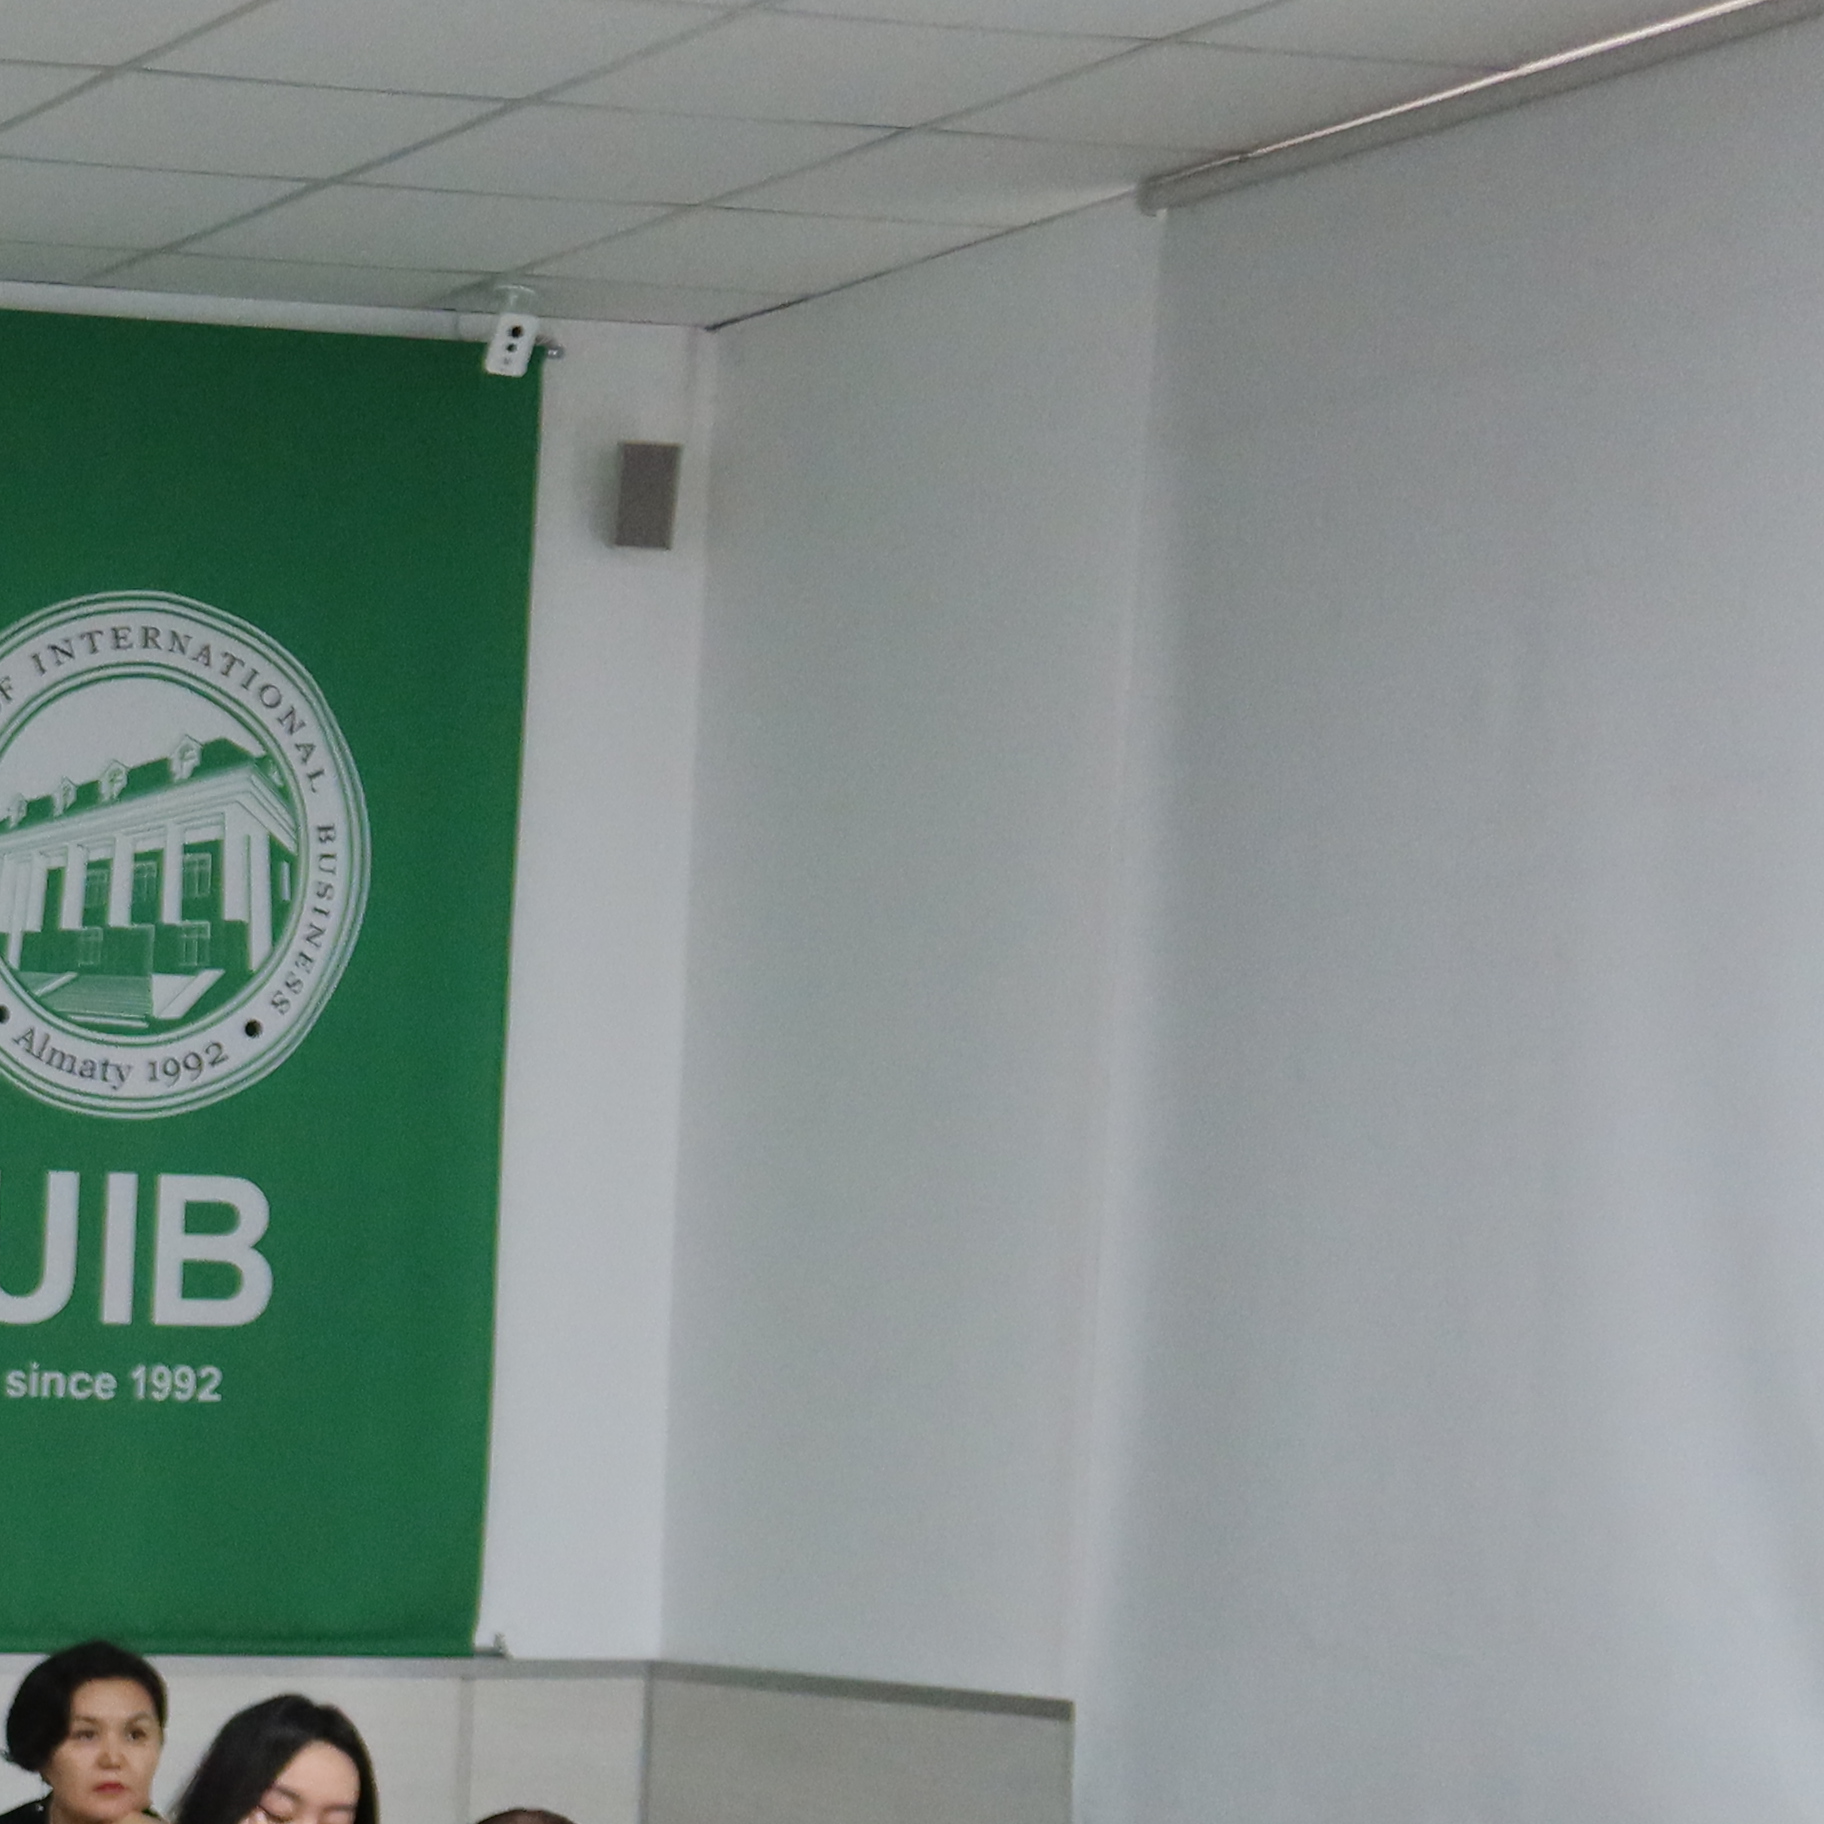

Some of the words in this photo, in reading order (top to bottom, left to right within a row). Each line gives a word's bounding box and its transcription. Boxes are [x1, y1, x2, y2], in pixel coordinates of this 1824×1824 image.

[30, 626, 331, 795] INTERNATIONAL
[271, 823, 339, 1017] BUSINESS
[13, 1027, 133, 1091] Almaty
[147, 1043, 230, 1087] 1992
[5, 1361, 117, 1400] since
[131, 1364, 224, 1402] 1992
